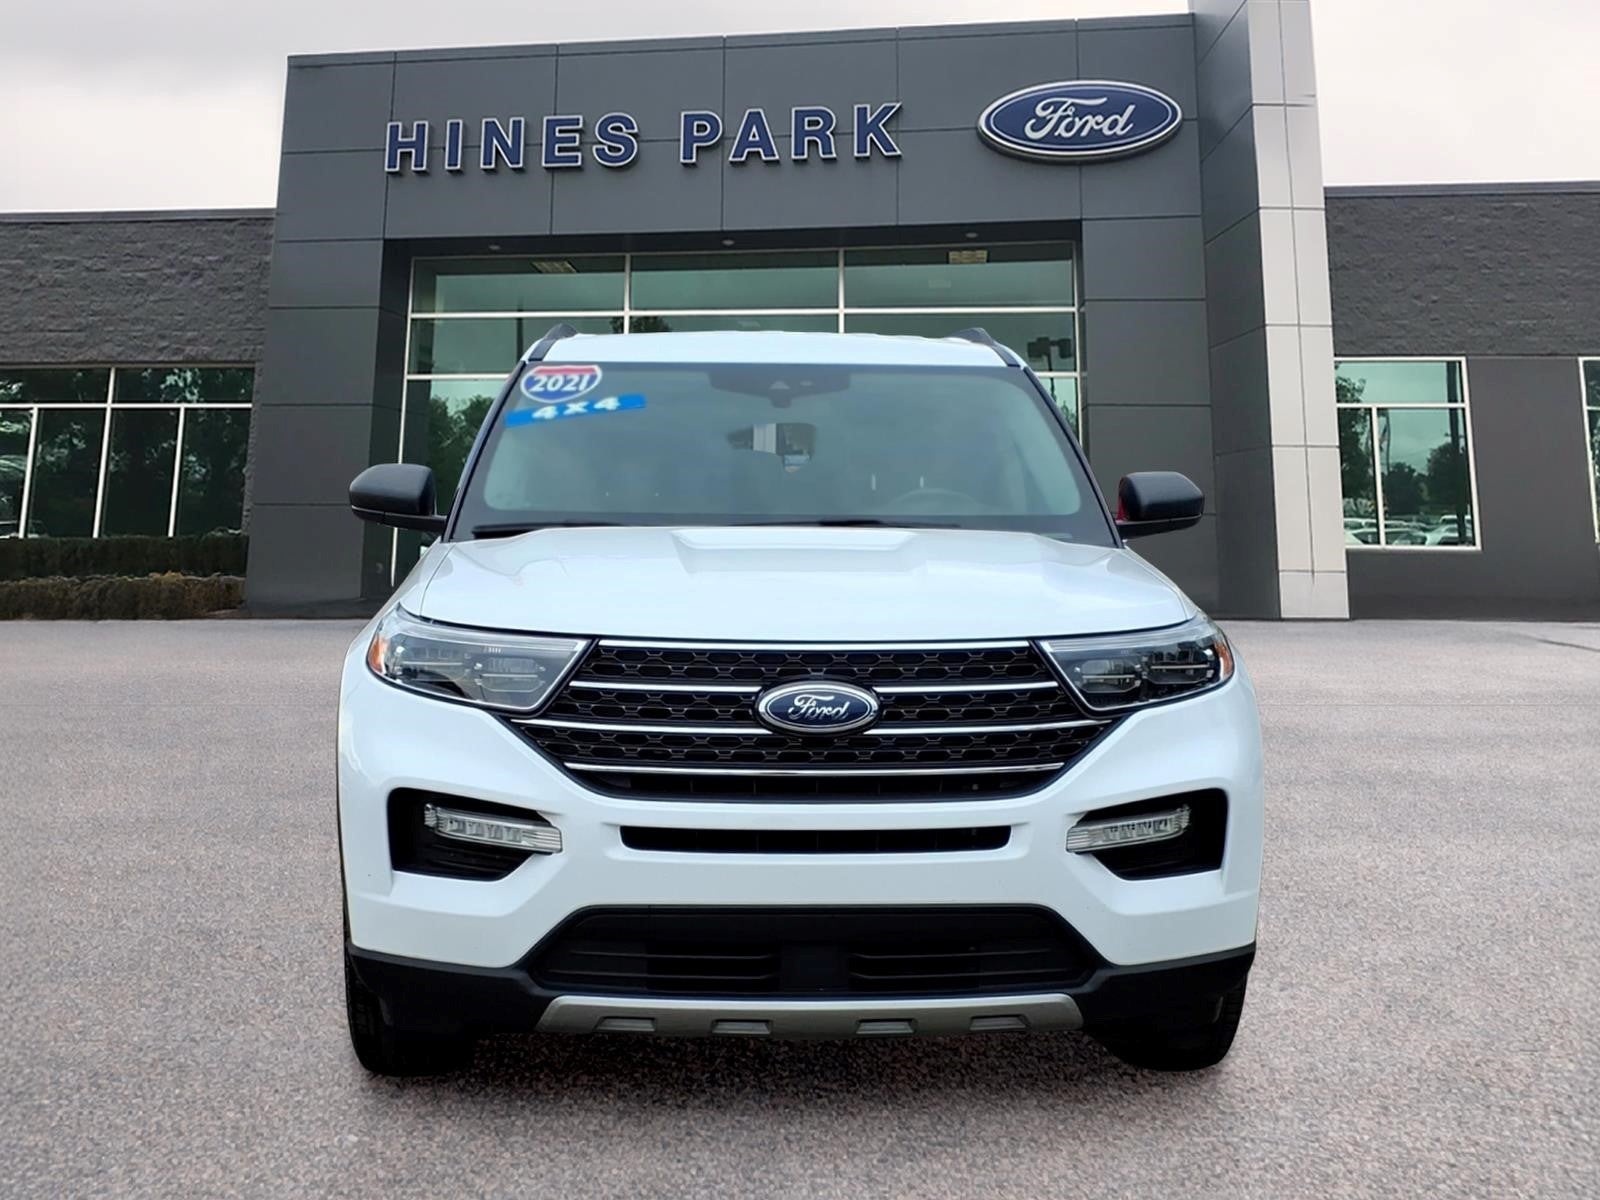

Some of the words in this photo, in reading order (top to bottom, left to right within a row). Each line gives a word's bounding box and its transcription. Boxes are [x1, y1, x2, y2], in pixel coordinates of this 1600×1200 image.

[1024, 97, 1136, 140] Ford
[384, 112, 639, 173] HINES
[680, 103, 903, 164] PARK
[529, 374, 591, 392] 2021
[788, 693, 850, 720] Ford
